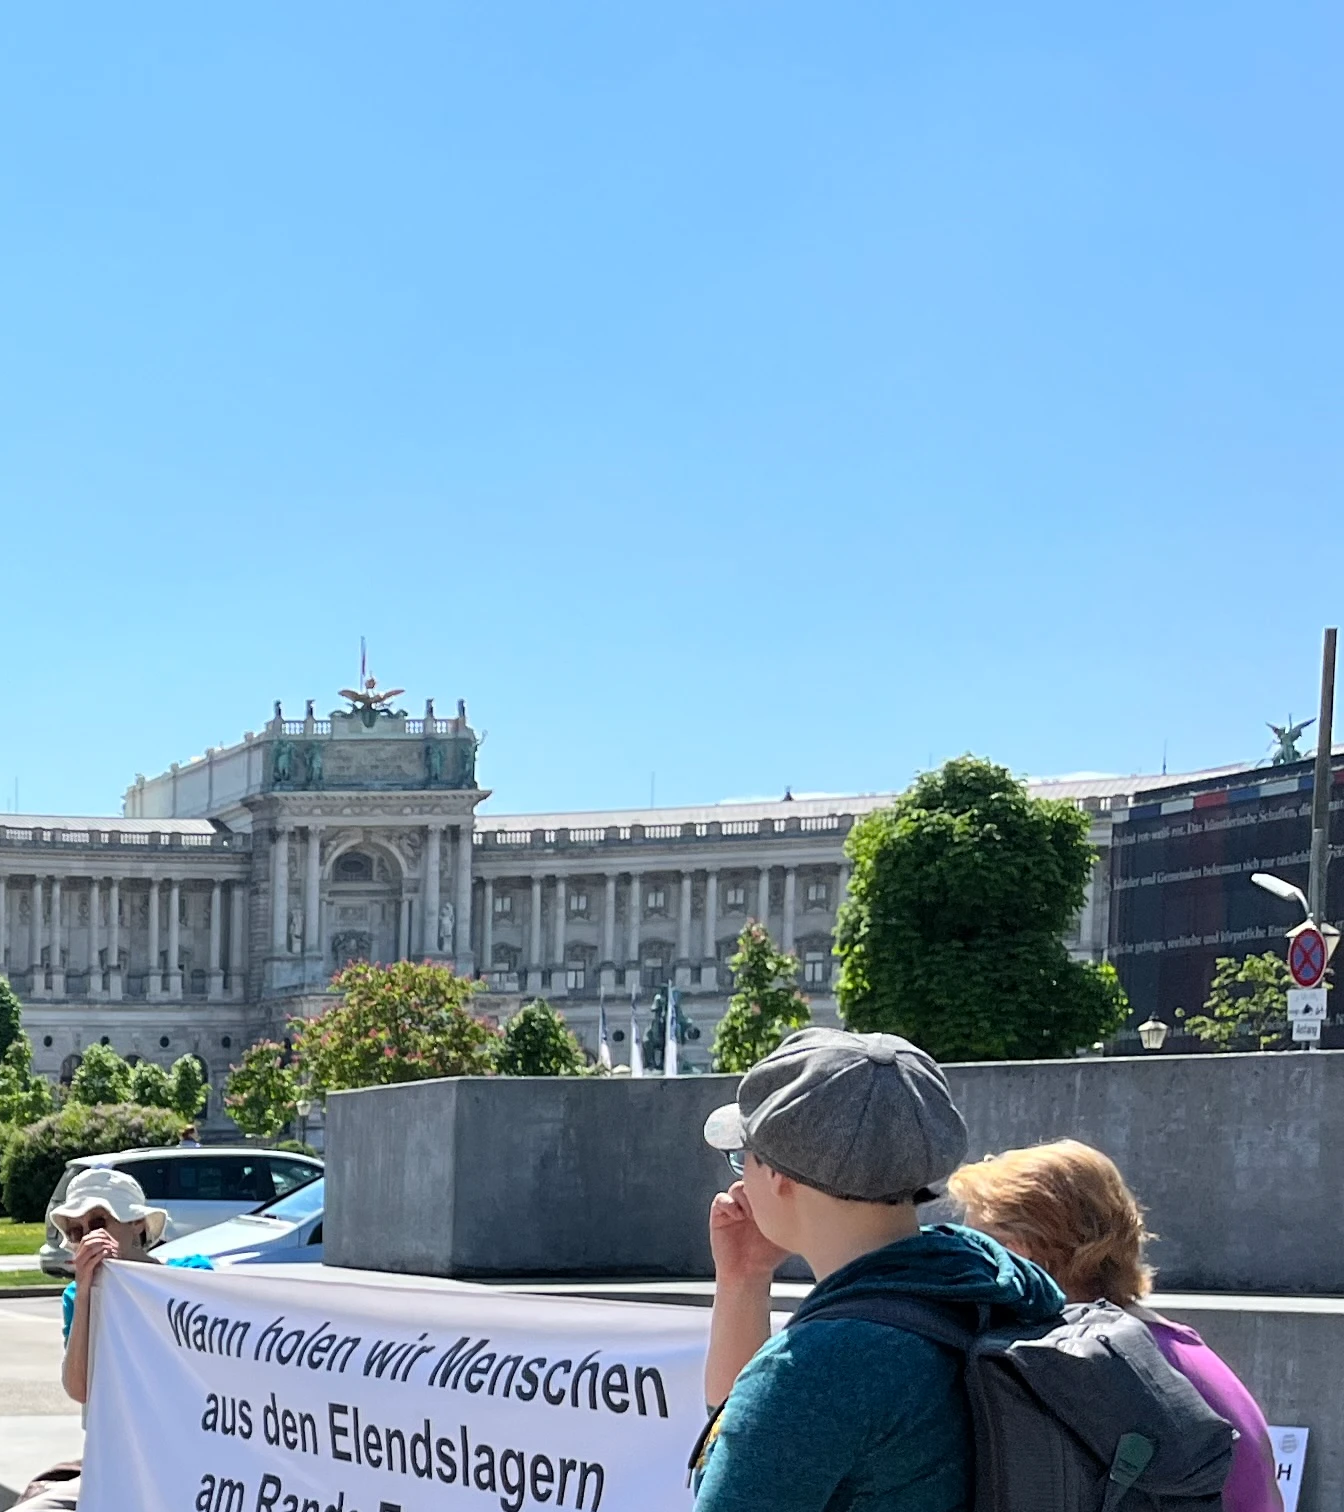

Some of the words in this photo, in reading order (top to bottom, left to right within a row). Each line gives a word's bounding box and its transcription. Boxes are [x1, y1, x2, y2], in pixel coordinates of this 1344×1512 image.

[167, 1298, 250, 1358] Wann
[253, 1315, 362, 1372] holen
[362, 1332, 435, 1382] wir
[427, 1335, 669, 1418] Menschen
[201, 1392, 253, 1440] aus
[262, 1392, 319, 1455] den
[327, 1402, 605, 1512] Elendslagern
